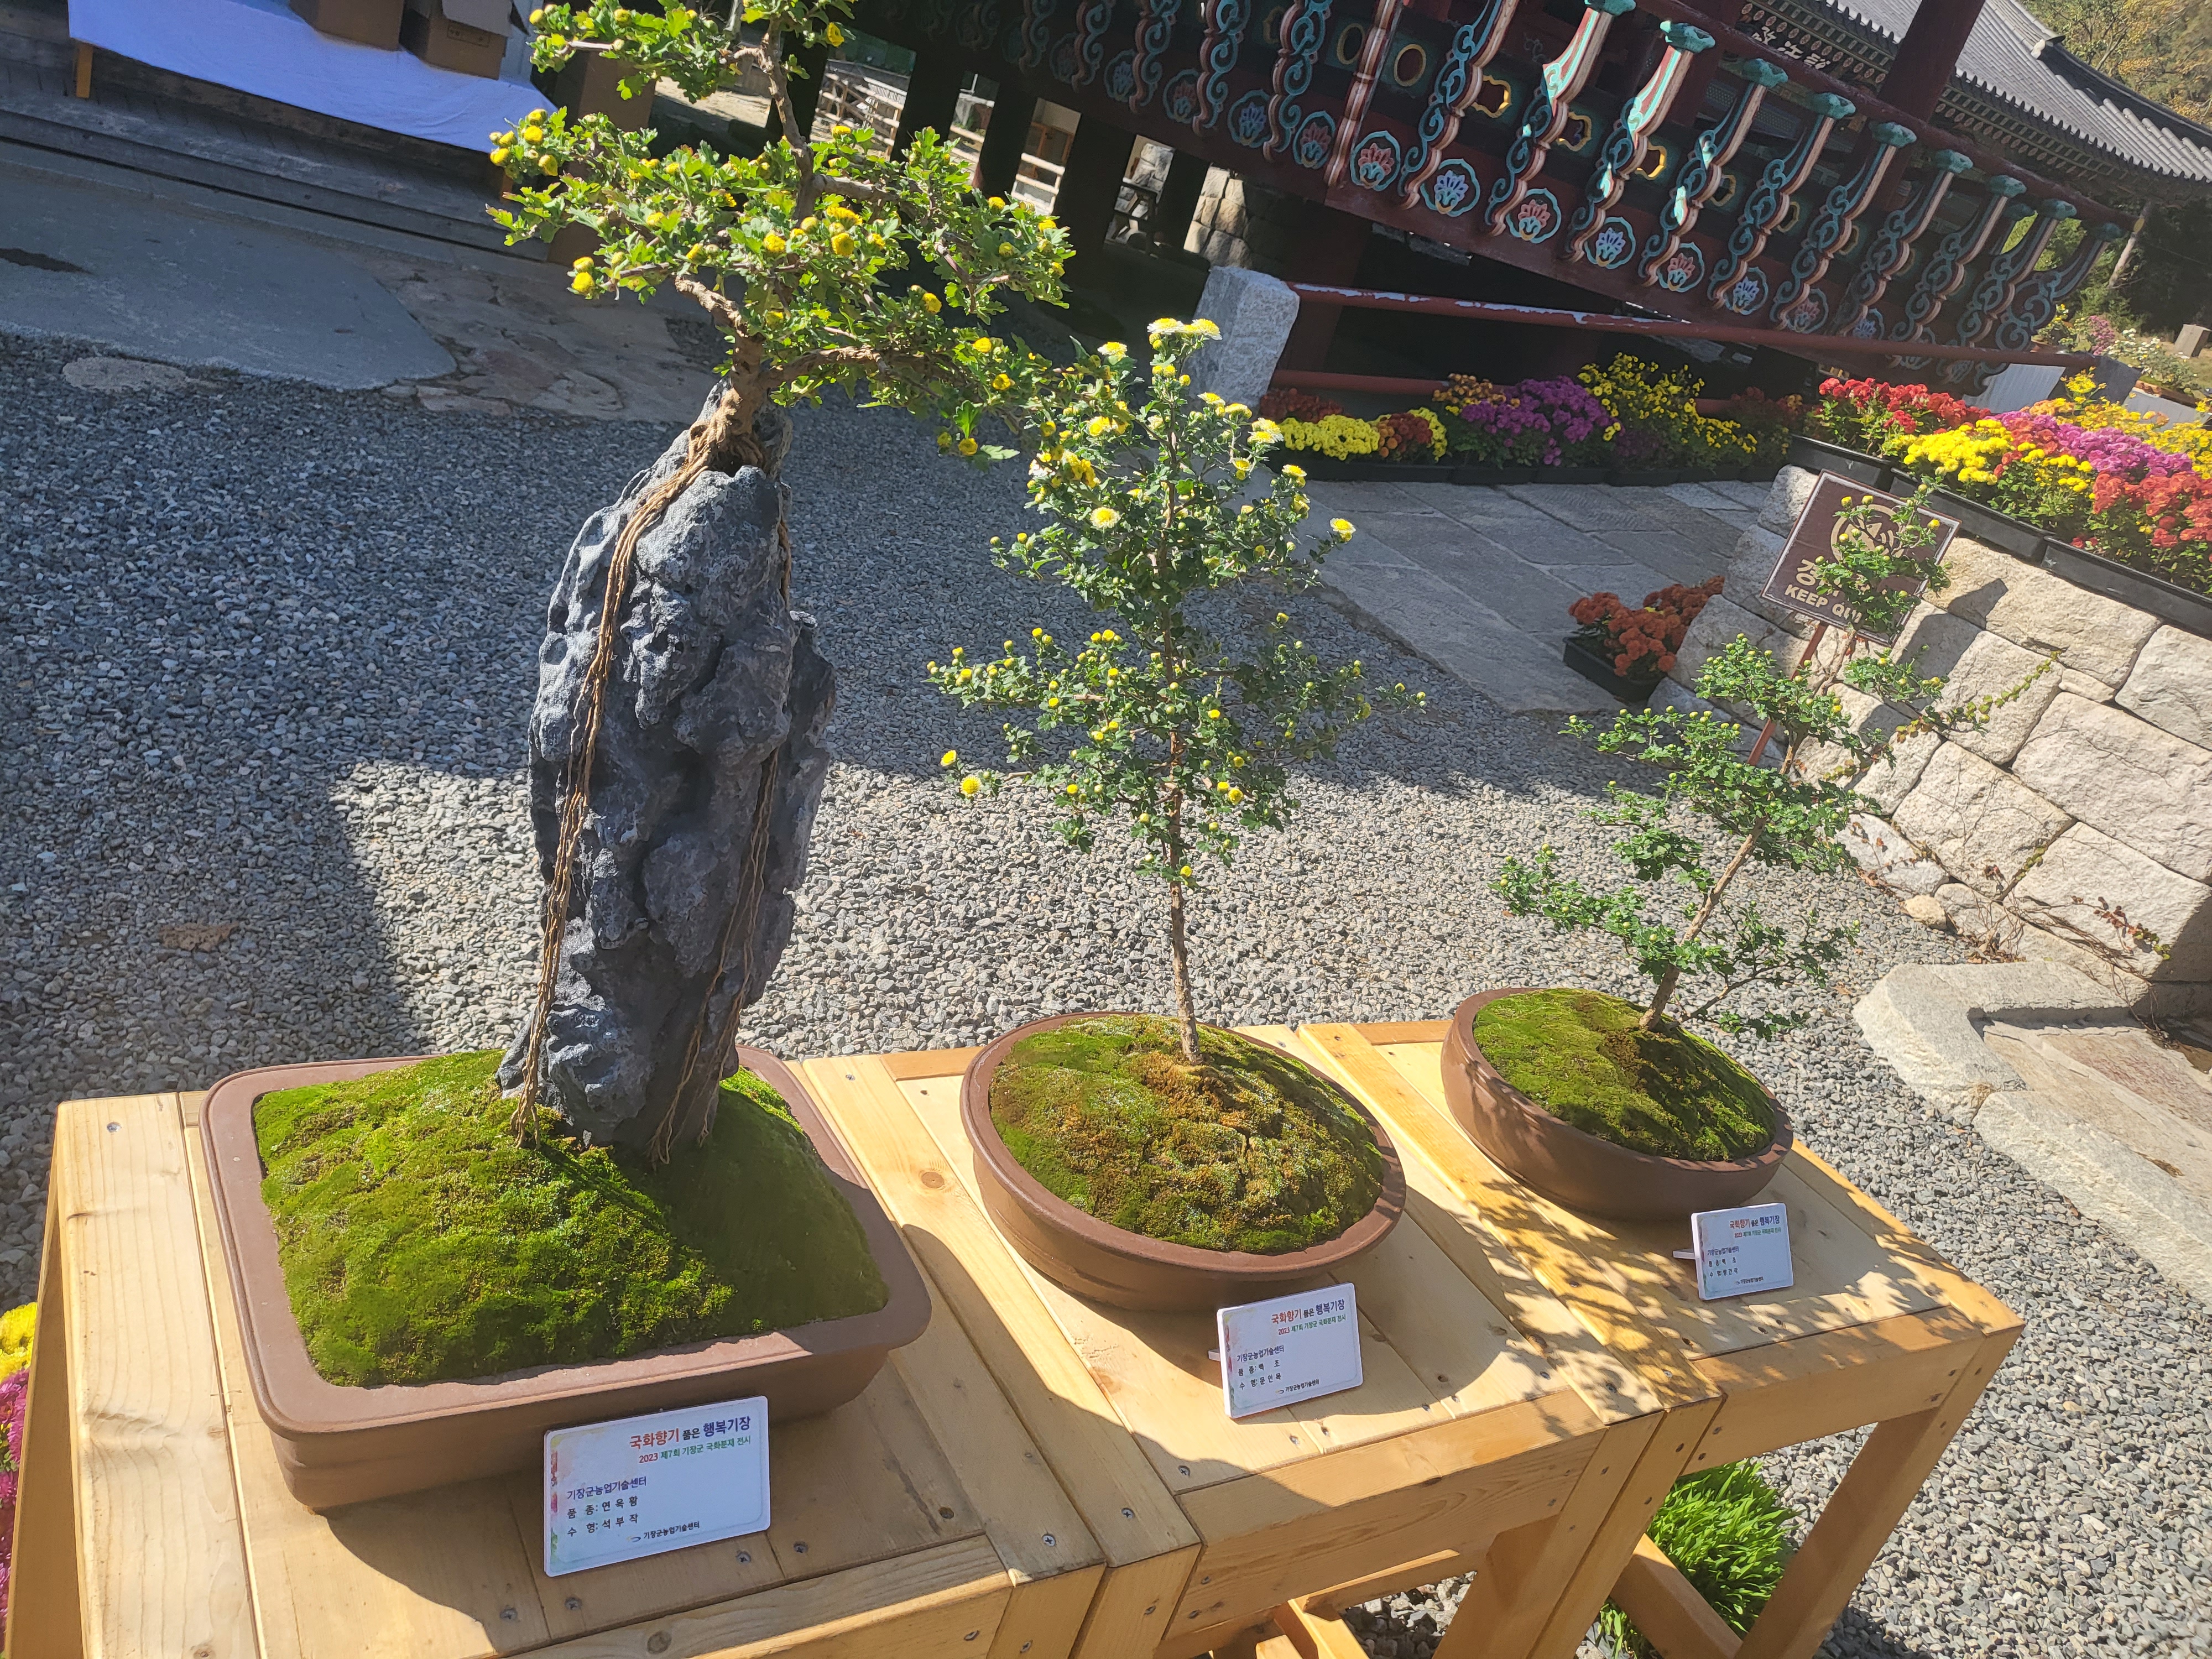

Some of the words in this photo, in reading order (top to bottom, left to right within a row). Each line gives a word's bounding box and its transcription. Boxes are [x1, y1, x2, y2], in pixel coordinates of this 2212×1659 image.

[1785, 584, 1828, 608] KEEP
[1271, 1308, 1302, 1324] 국화향기
[1316, 1299, 1344, 1315] 행복기장
[1237, 1345, 1284, 1362] 기장군농업기술센터
[630, 1428, 679, 1449] 국화향기
[682, 1428, 700, 1441] 품은
[703, 1416, 750, 1437] 행복기장
[639, 1453, 658, 1463] 2023
[661, 1448, 680, 1459] 제7회
[682, 1444, 703, 1455] 기장군
[706, 1438, 734, 1451] 국화분재
[737, 1436, 750, 1446] 전시
[567, 1476, 646, 1500] 기장군농업기술센터
[644, 1521, 700, 1539] 기장군농업기술센터
